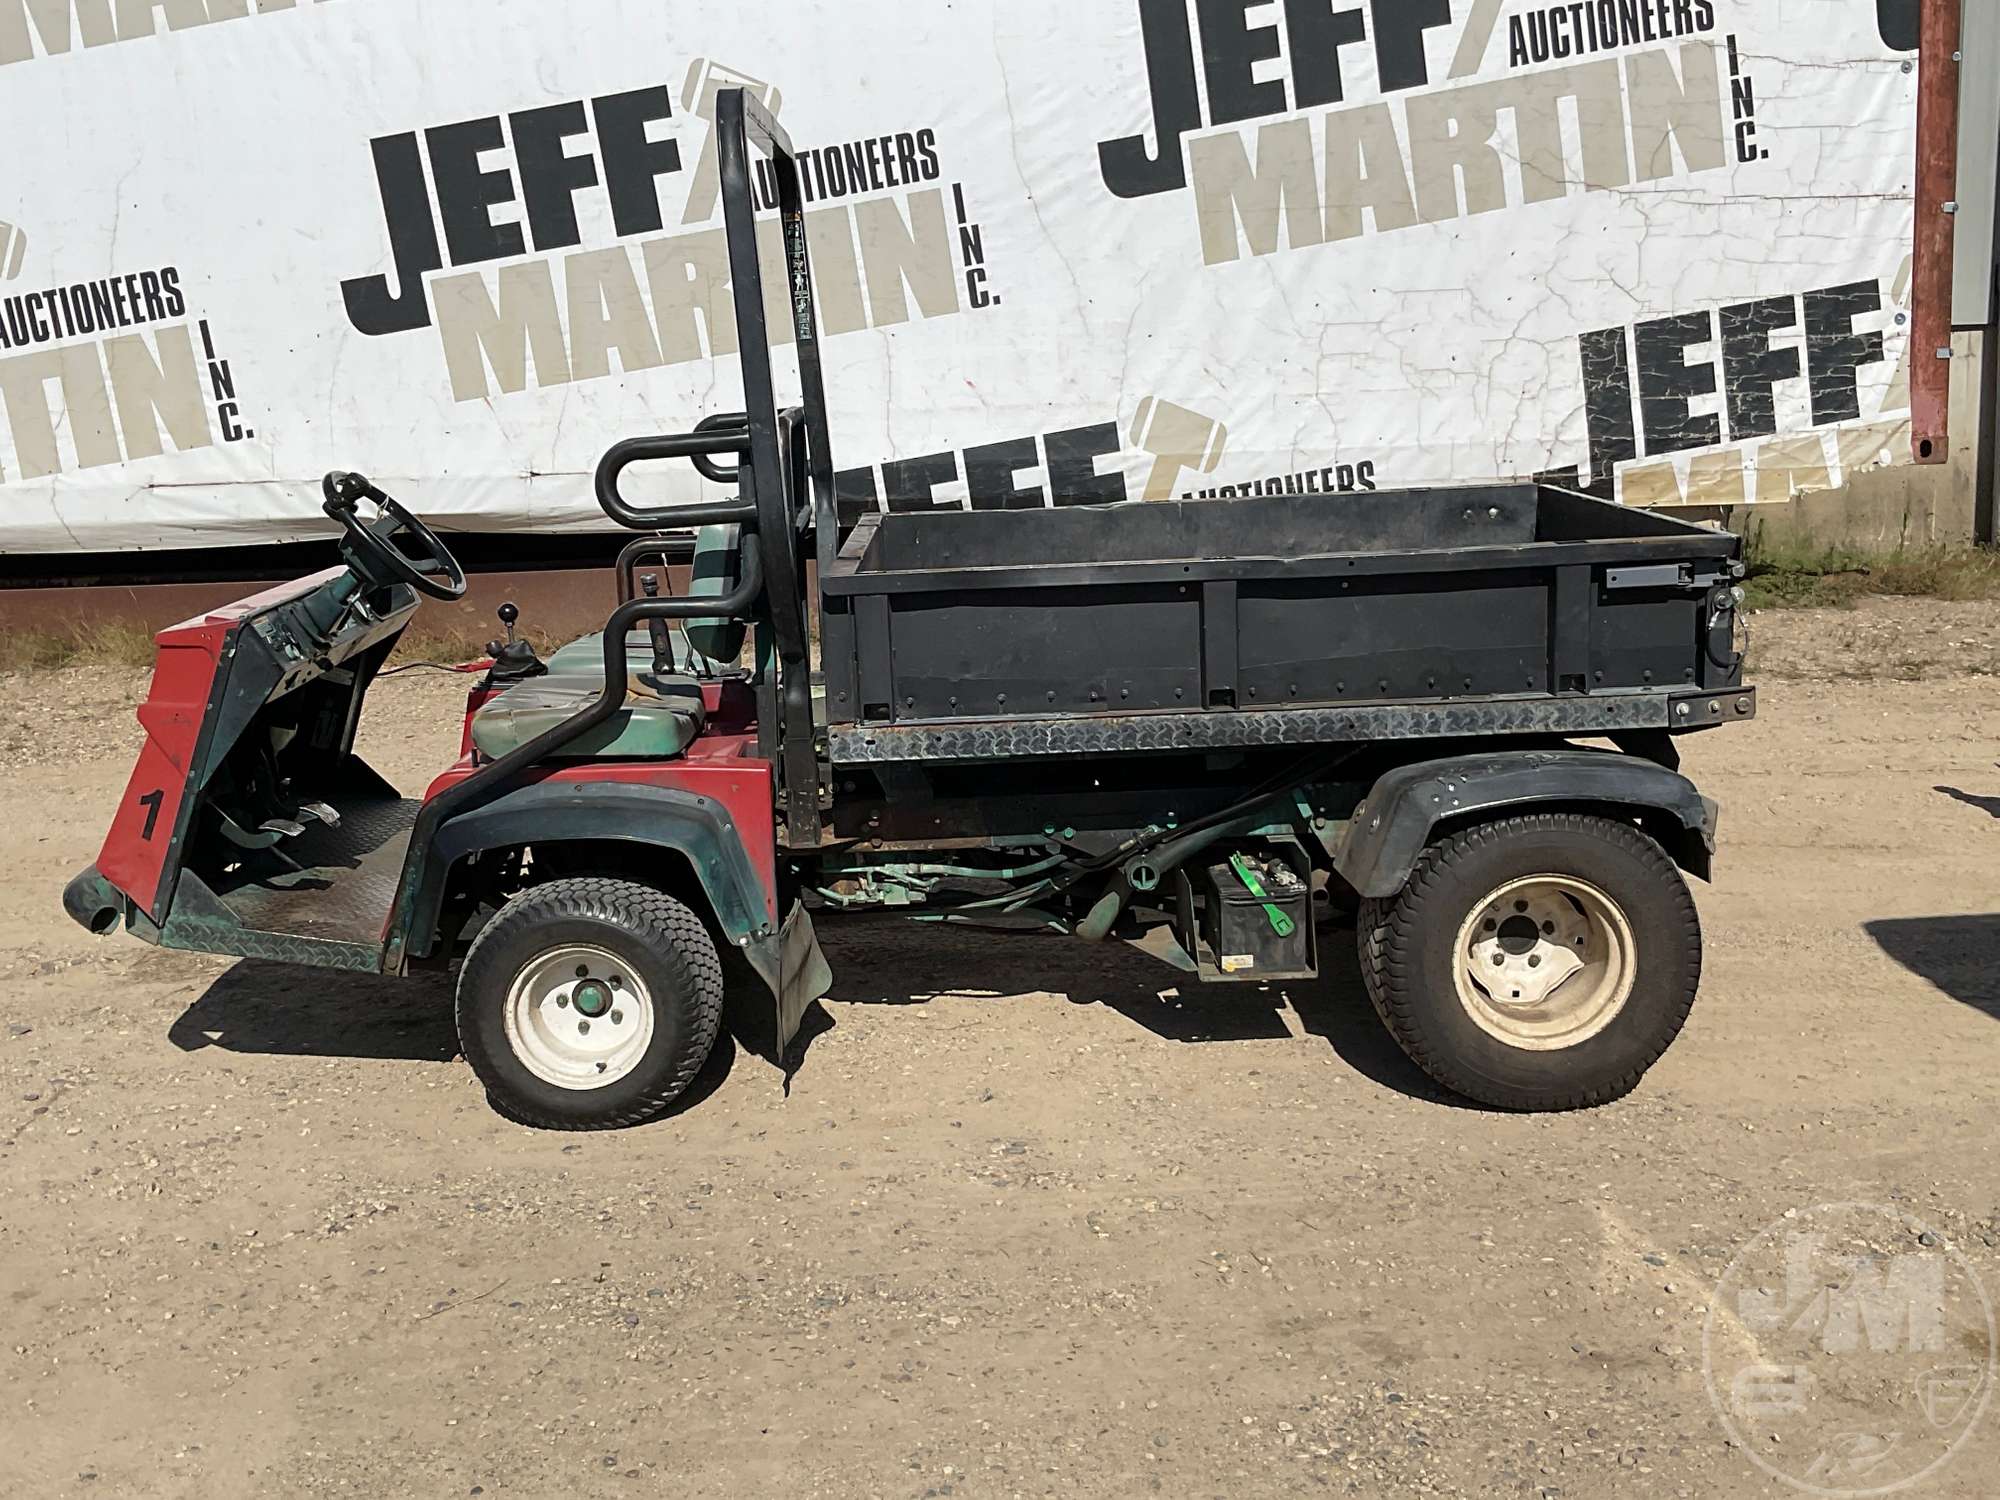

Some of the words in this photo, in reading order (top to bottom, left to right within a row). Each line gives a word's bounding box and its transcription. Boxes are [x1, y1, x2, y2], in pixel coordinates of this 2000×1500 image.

[1097, 0, 1452, 199] JEFF
[1508, 0, 1715, 68] AUCTIONEERS
[340, 85, 683, 336] JEFF
[752, 128, 940, 212] UTIONEERS
[1188, 39, 1727, 266] MARTIN
[1533, 278, 1885, 500] JEFF
[140, 789, 165, 841] 1
